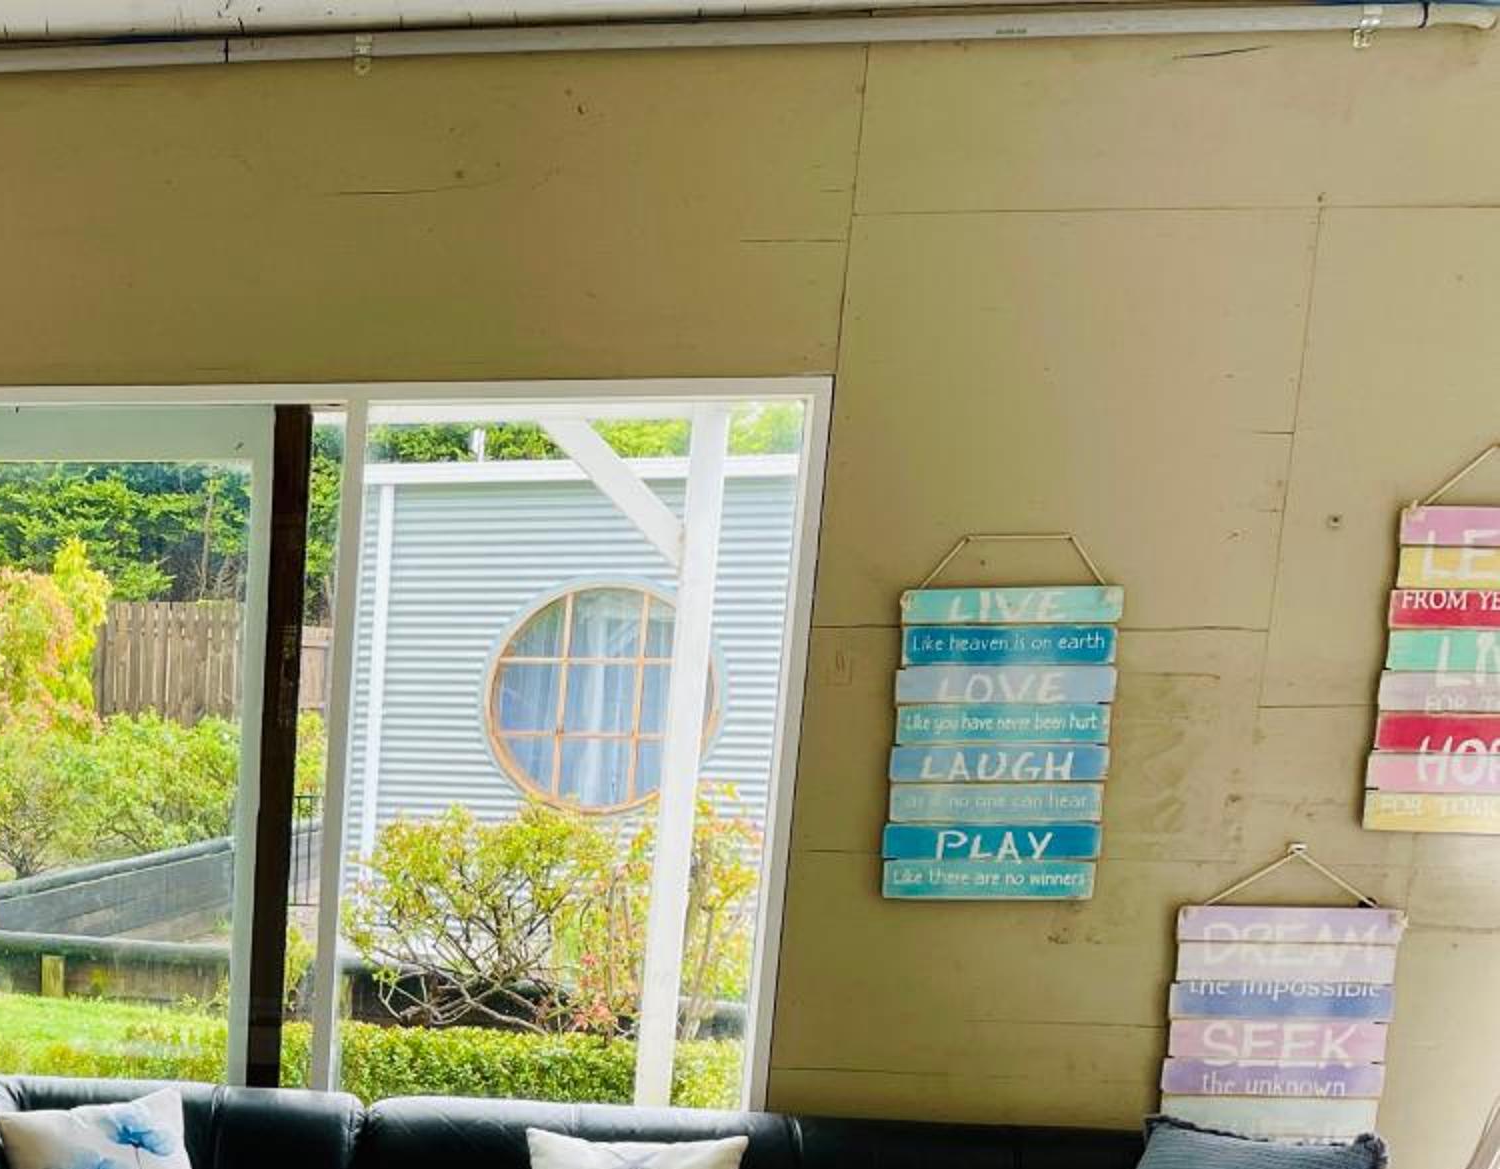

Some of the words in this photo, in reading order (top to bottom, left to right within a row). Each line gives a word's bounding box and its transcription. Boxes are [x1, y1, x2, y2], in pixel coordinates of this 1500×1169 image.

[950, 590, 1068, 621] LIVE
[1402, 590, 1468, 611] FROM
[912, 635, 944, 652] Like
[949, 635, 1009, 651] heaven
[1014, 633, 1026, 651] is
[1031, 638, 1051, 651] on
[1058, 631, 1106, 650] earth
[936, 671, 1068, 704] LOVE
[904, 713, 931, 731] Like
[962, 713, 995, 731] have
[1035, 712, 1065, 731] been
[1069, 711, 1099, 730] hurt
[920, 751, 1076, 781] LAUGH
[936, 830, 1054, 864] PLAY
[893, 868, 923, 885] Like
[929, 868, 968, 884] there
[973, 872, 1000, 885] are
[1004, 872, 1025, 885] no
[1028, 872, 1087, 886] winners
[1202, 921, 1379, 967] DREAM
[1188, 977, 1231, 996] the
[1240, 977, 1381, 1002] impossible
[1201, 1021, 1357, 1070] SEEK
[1201, 1070, 1236, 1094] the
[1245, 1075, 1347, 1098] unknown
